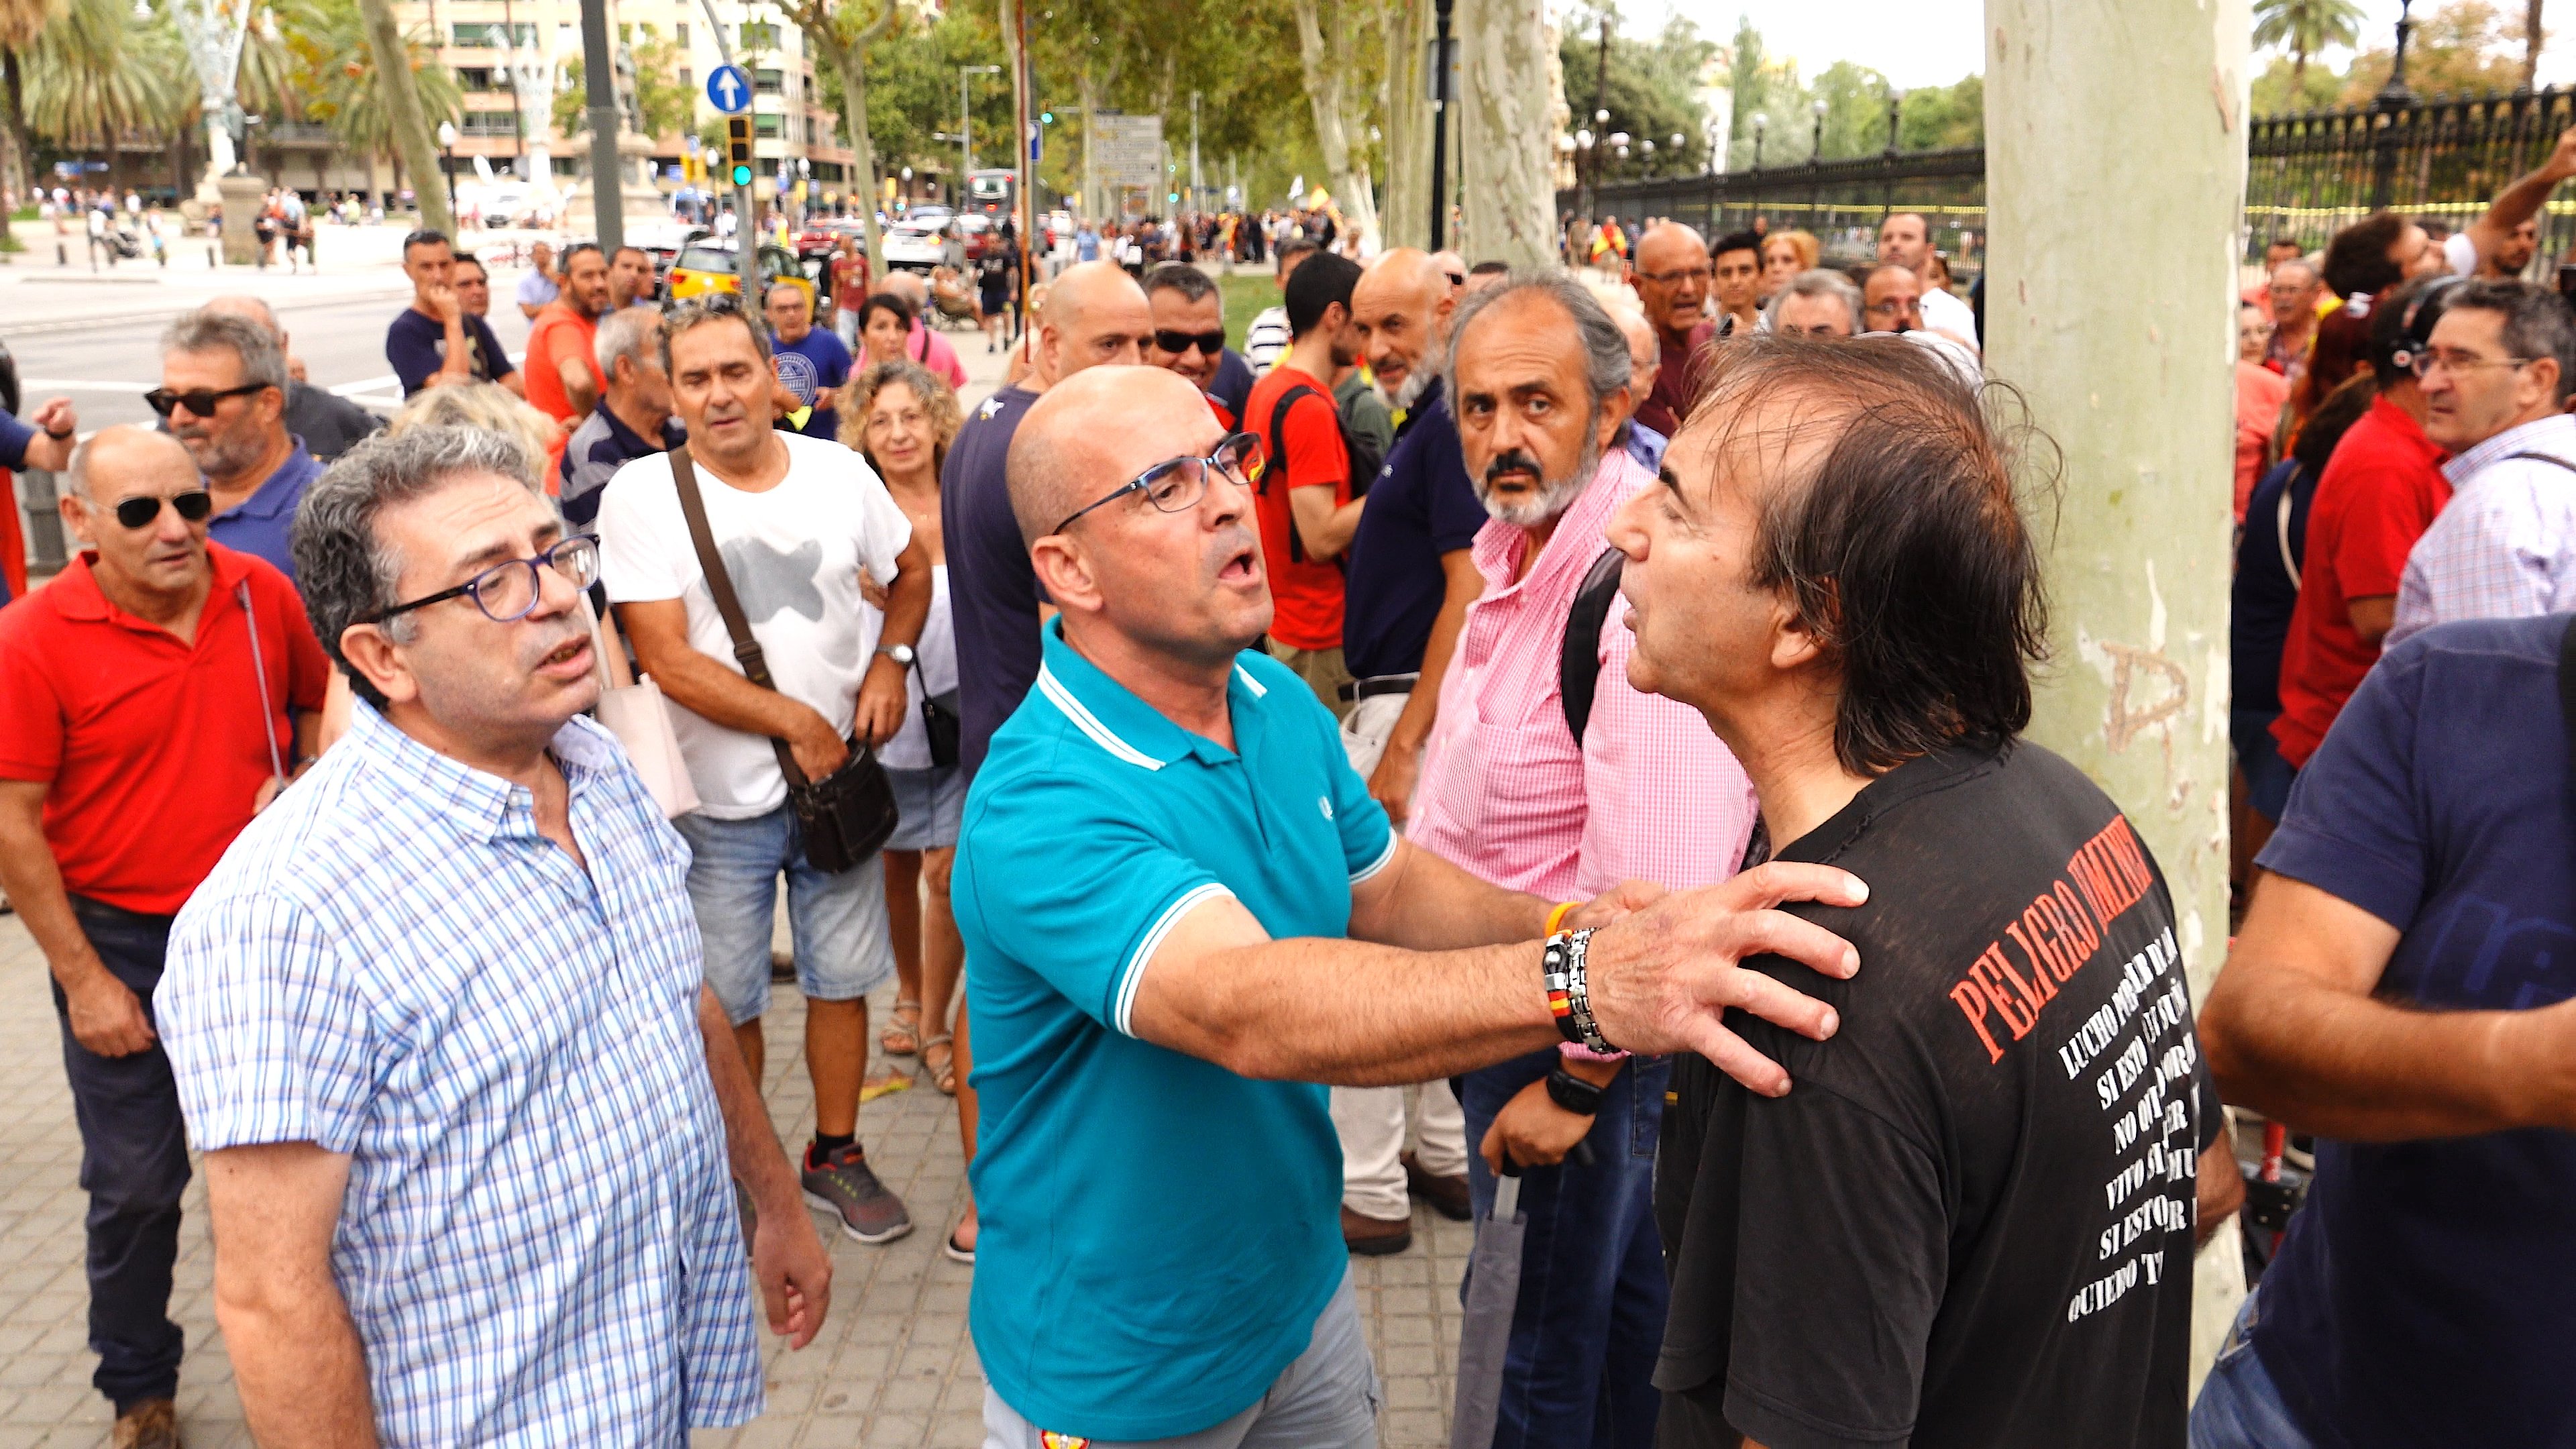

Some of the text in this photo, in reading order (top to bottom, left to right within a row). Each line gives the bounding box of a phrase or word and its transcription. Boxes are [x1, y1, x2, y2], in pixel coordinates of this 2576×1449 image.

[1949, 879, 2101, 1065] PELIGRO
[2058, 1003, 2118, 1080] LUCHO
[2096, 1068, 2120, 1110] SI
[2115, 1036, 2147, 1092] ESTO
[2113, 1111, 2137, 1155] NO
[2105, 1159, 2145, 1211] VIVO
[2099, 1223, 2121, 1260] SI
